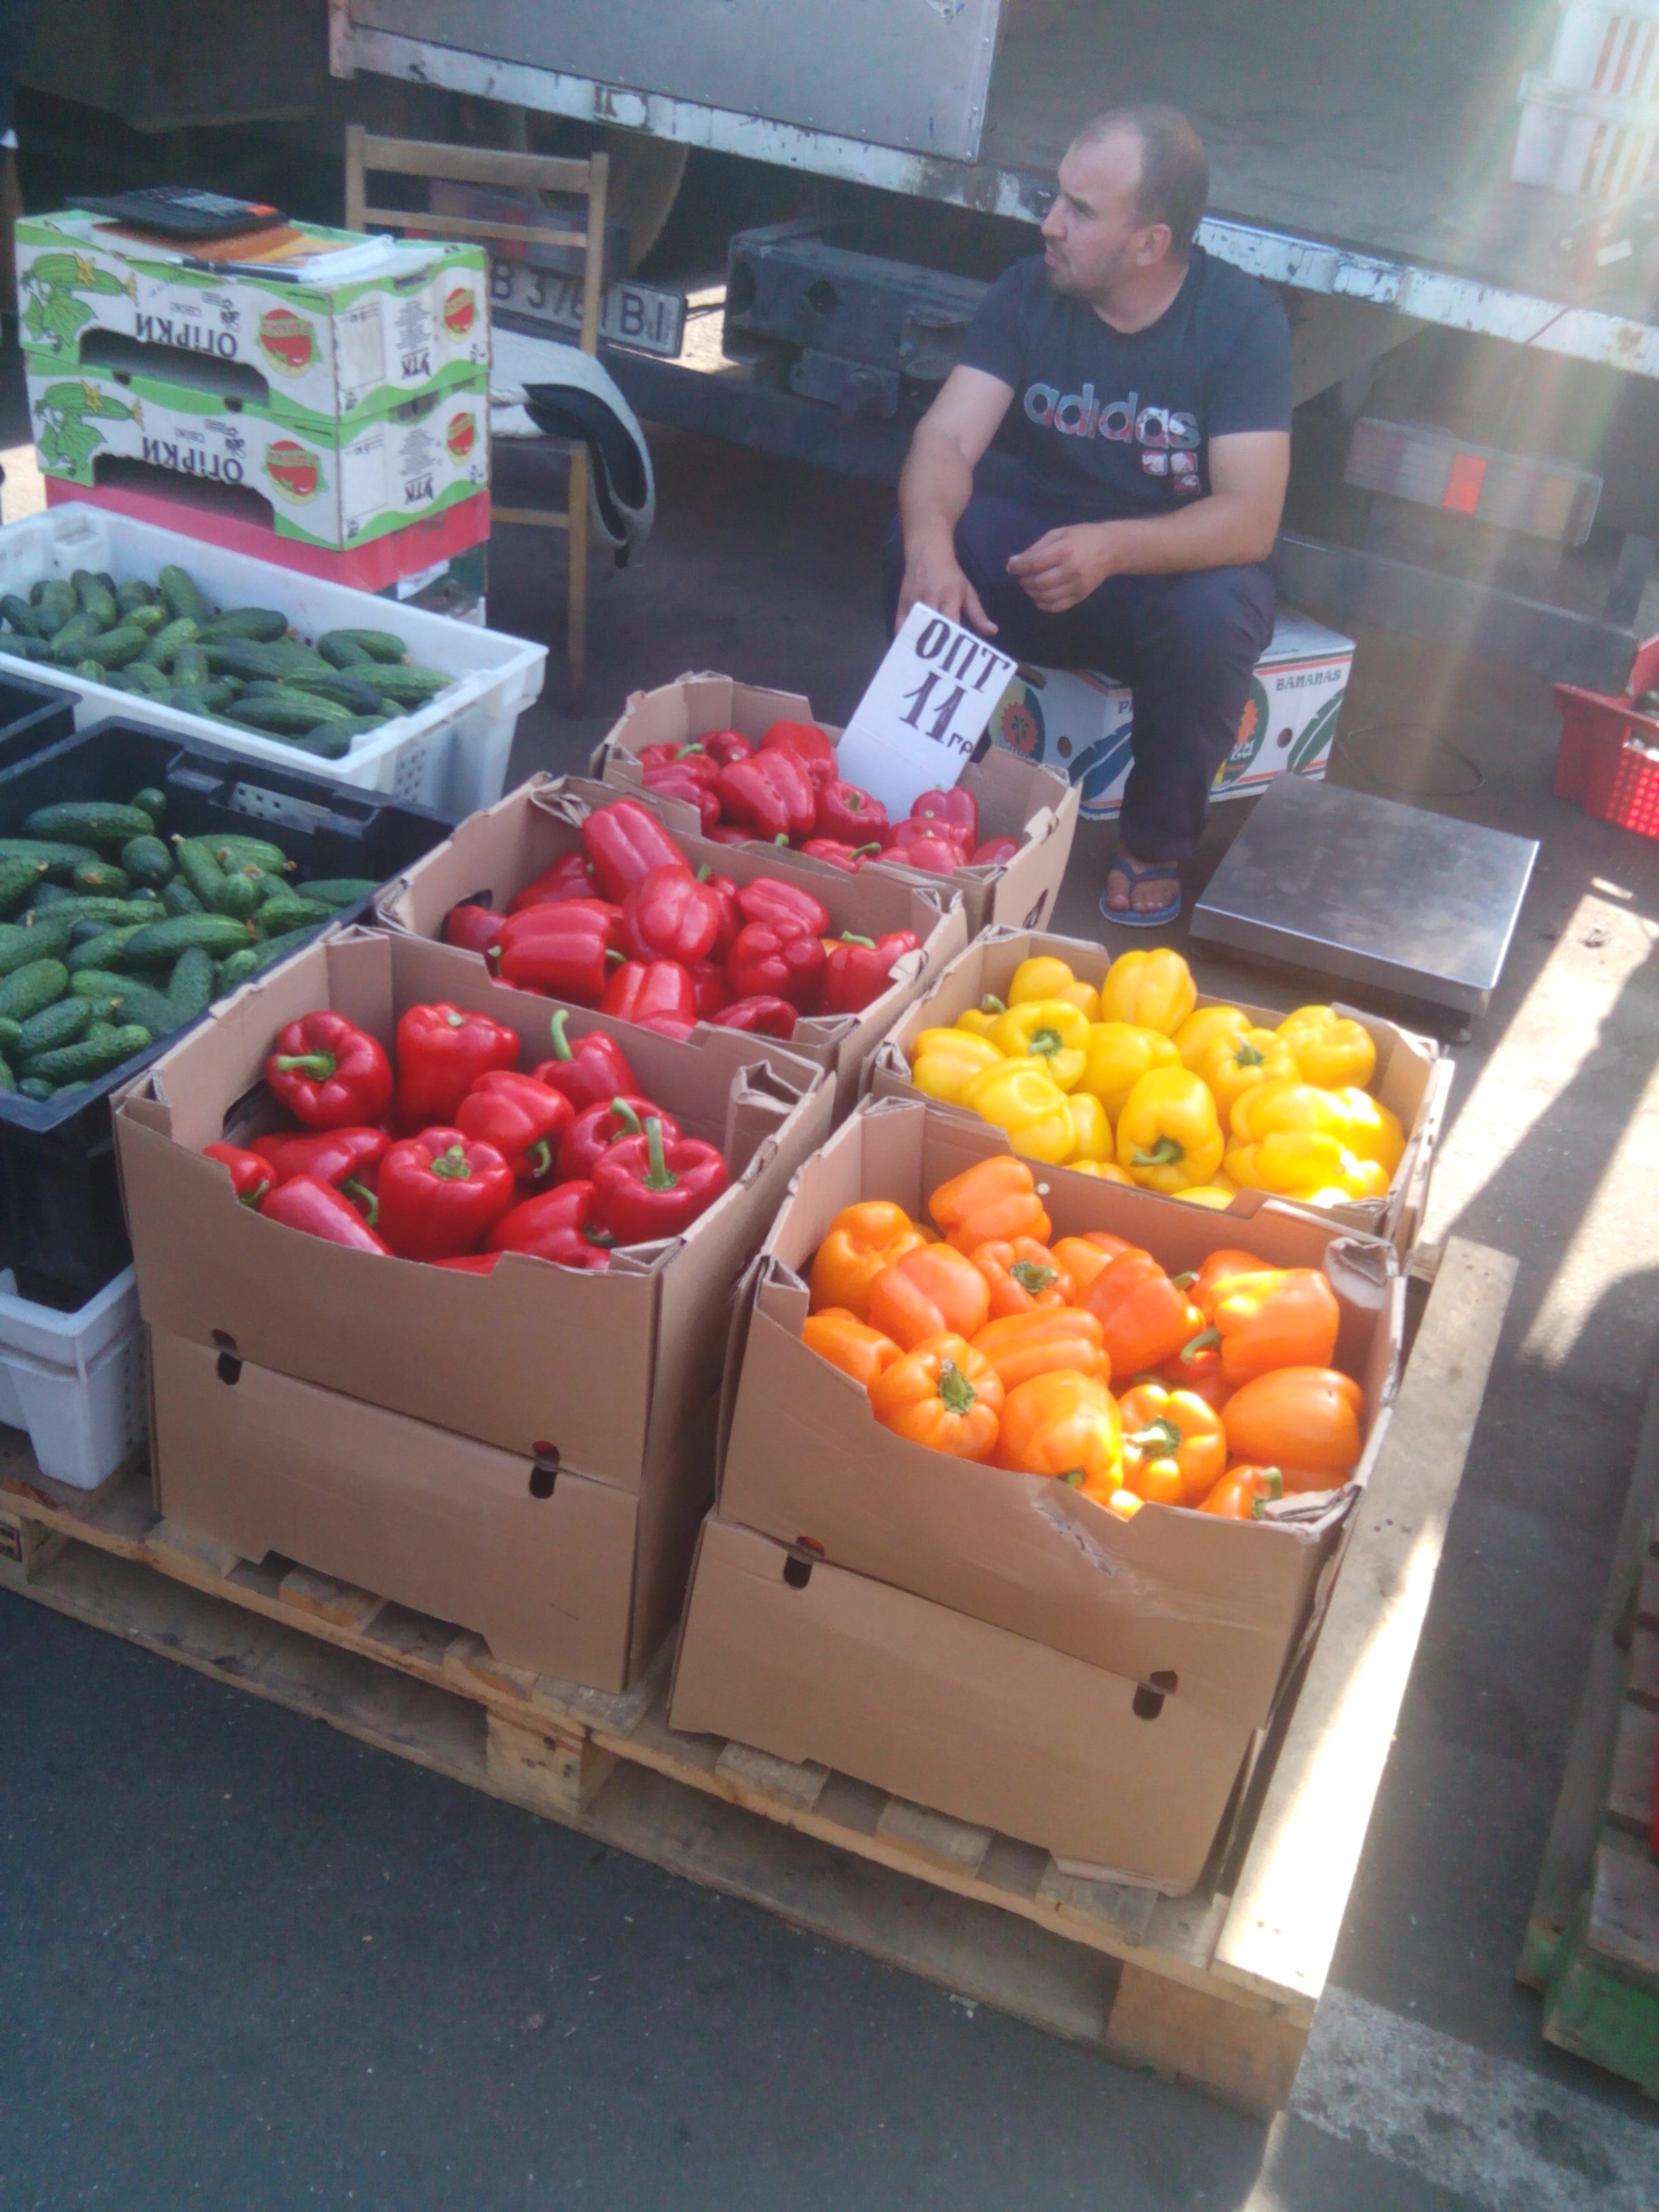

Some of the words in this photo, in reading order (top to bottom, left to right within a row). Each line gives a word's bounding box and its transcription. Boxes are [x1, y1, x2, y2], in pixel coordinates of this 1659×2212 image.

[1023, 383, 1201, 449] adidas
[915, 618, 1010, 693] ОПТ
[1275, 669, 1342, 691] BANANAS
